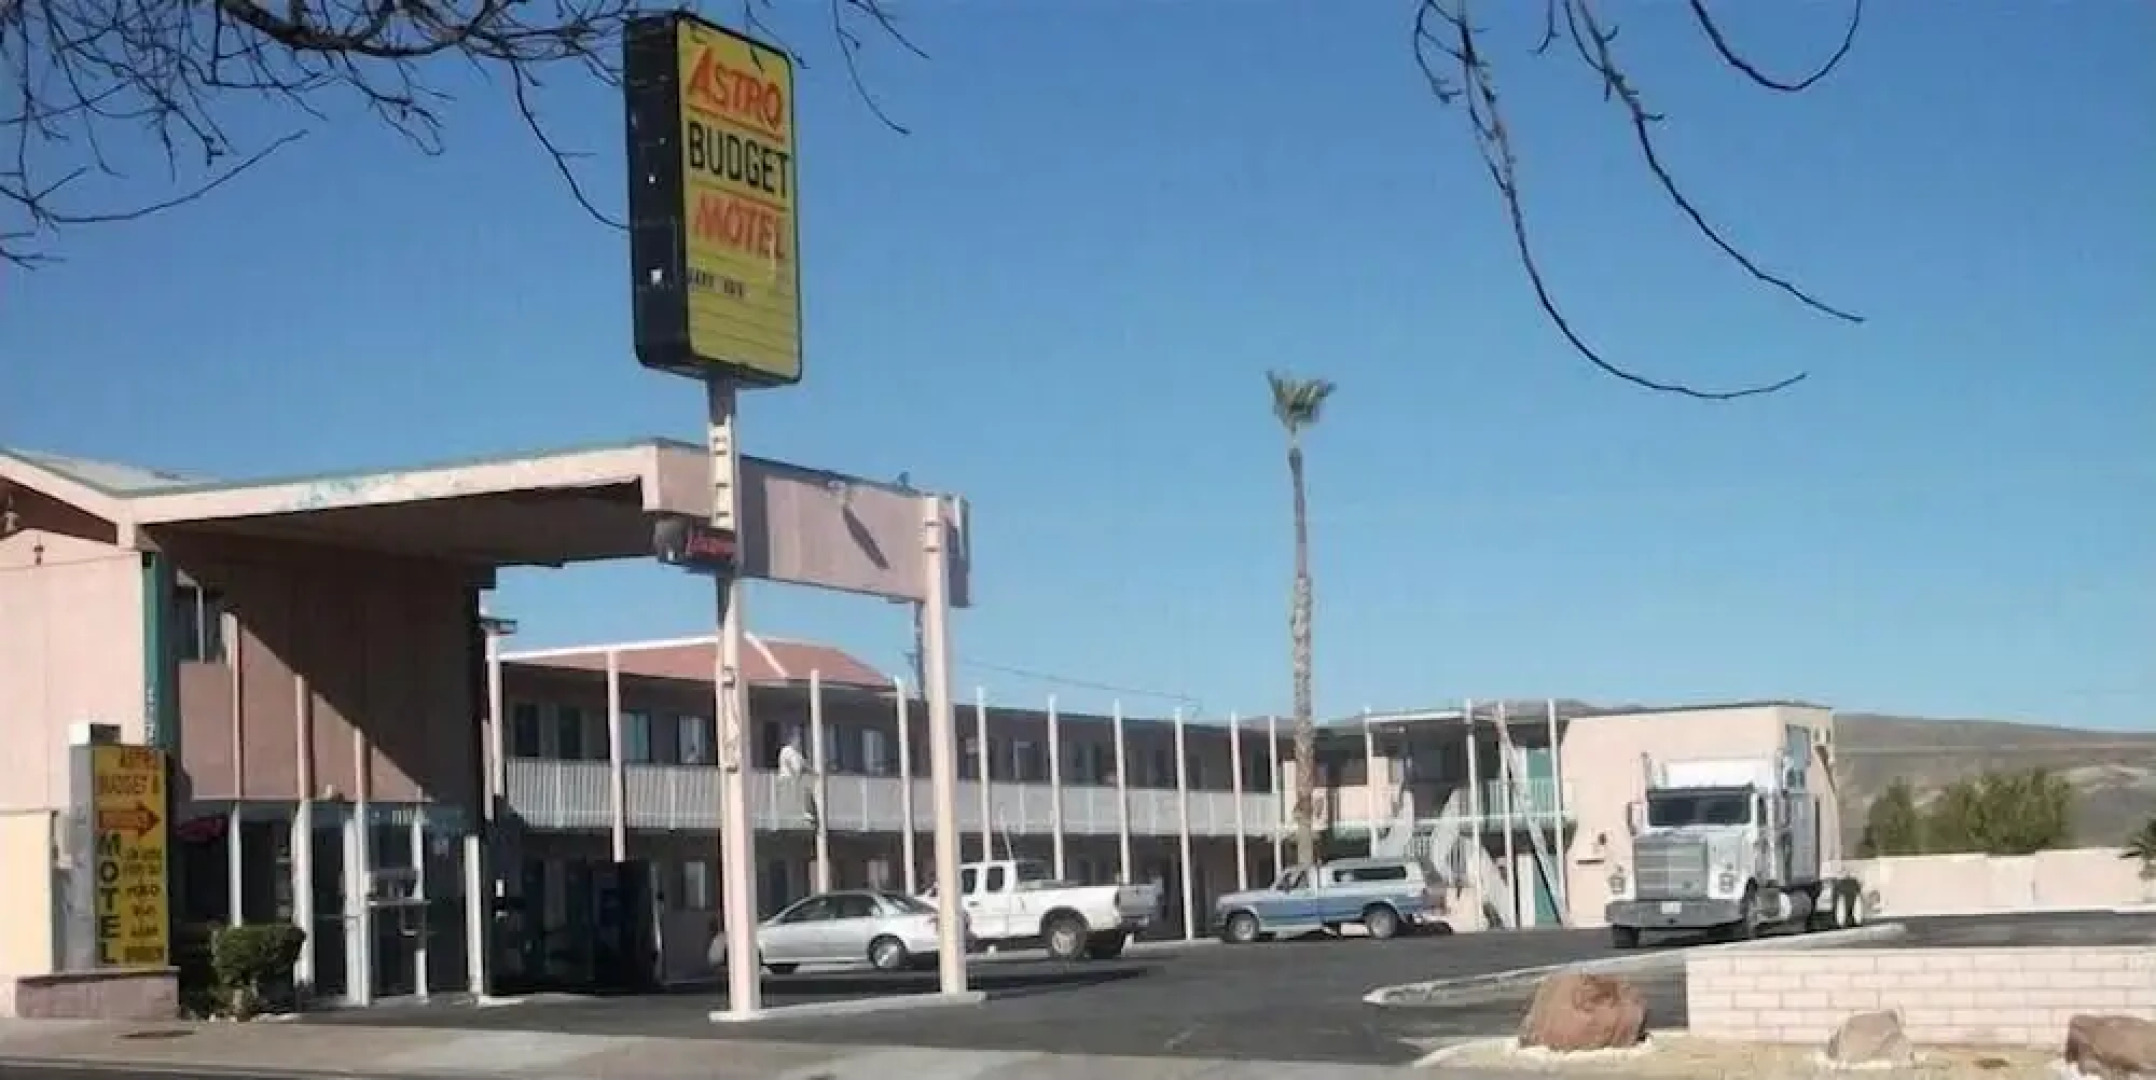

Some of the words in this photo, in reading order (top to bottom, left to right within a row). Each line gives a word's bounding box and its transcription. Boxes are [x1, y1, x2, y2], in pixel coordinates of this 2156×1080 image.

[687, 44, 784, 131] ASTRO
[688, 121, 790, 200] BUDGET
[694, 191, 785, 261] MOTEL
[98, 834, 122, 964] MOTEL
